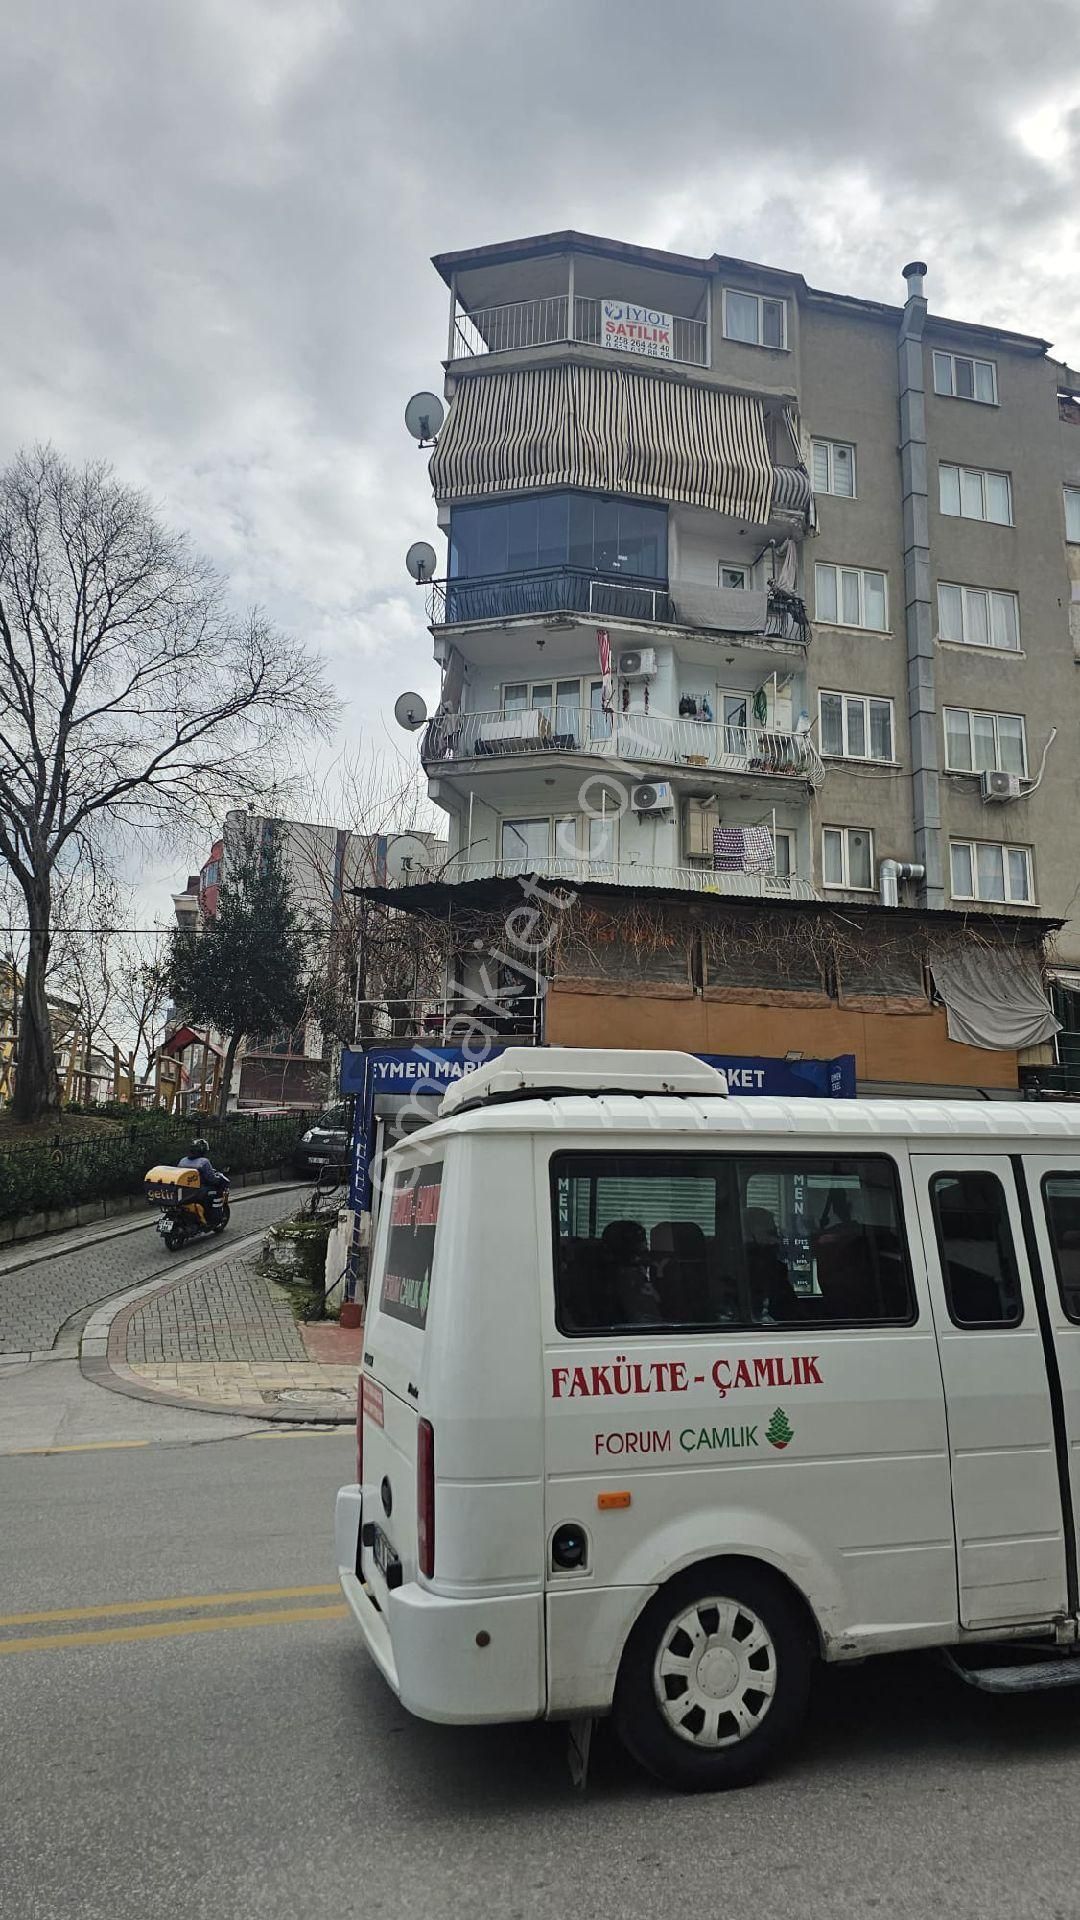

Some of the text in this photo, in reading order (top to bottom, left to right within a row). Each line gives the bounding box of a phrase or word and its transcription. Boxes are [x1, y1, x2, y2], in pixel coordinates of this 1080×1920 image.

[605, 320, 670, 345] SATILIK
[147, 1188, 174, 1201] getir
[551, 1355, 689, 1398] FAKÜLTE
[711, 1355, 824, 1399] ÇAMLIK
[594, 1425, 760, 1456] FORUM ÇAMLIK
